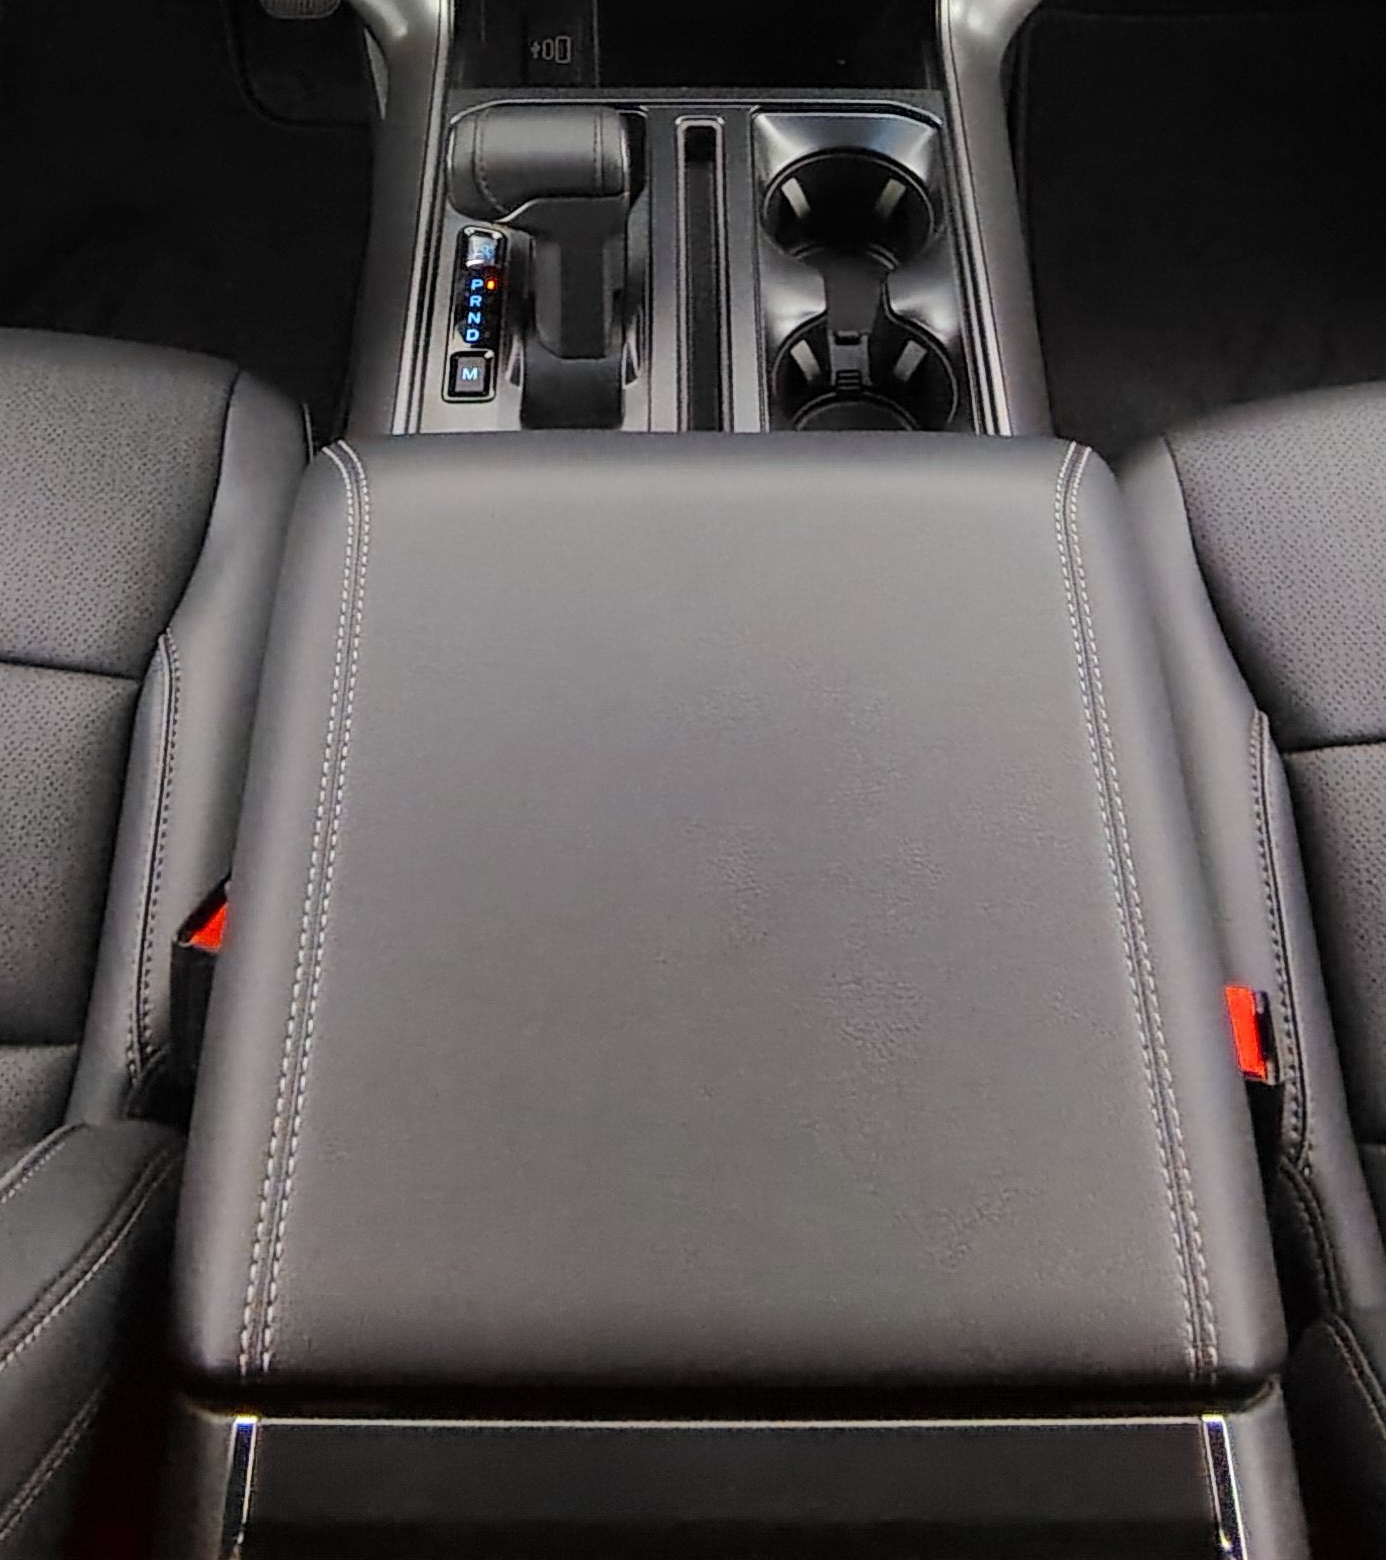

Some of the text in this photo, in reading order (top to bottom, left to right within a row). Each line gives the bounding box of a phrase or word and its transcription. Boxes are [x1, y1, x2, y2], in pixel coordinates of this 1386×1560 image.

[471, 279, 483, 291] P
[469, 295, 482, 307] R
[467, 312, 481, 325] N
[465, 328, 480, 341] D
[461, 367, 479, 381] M
